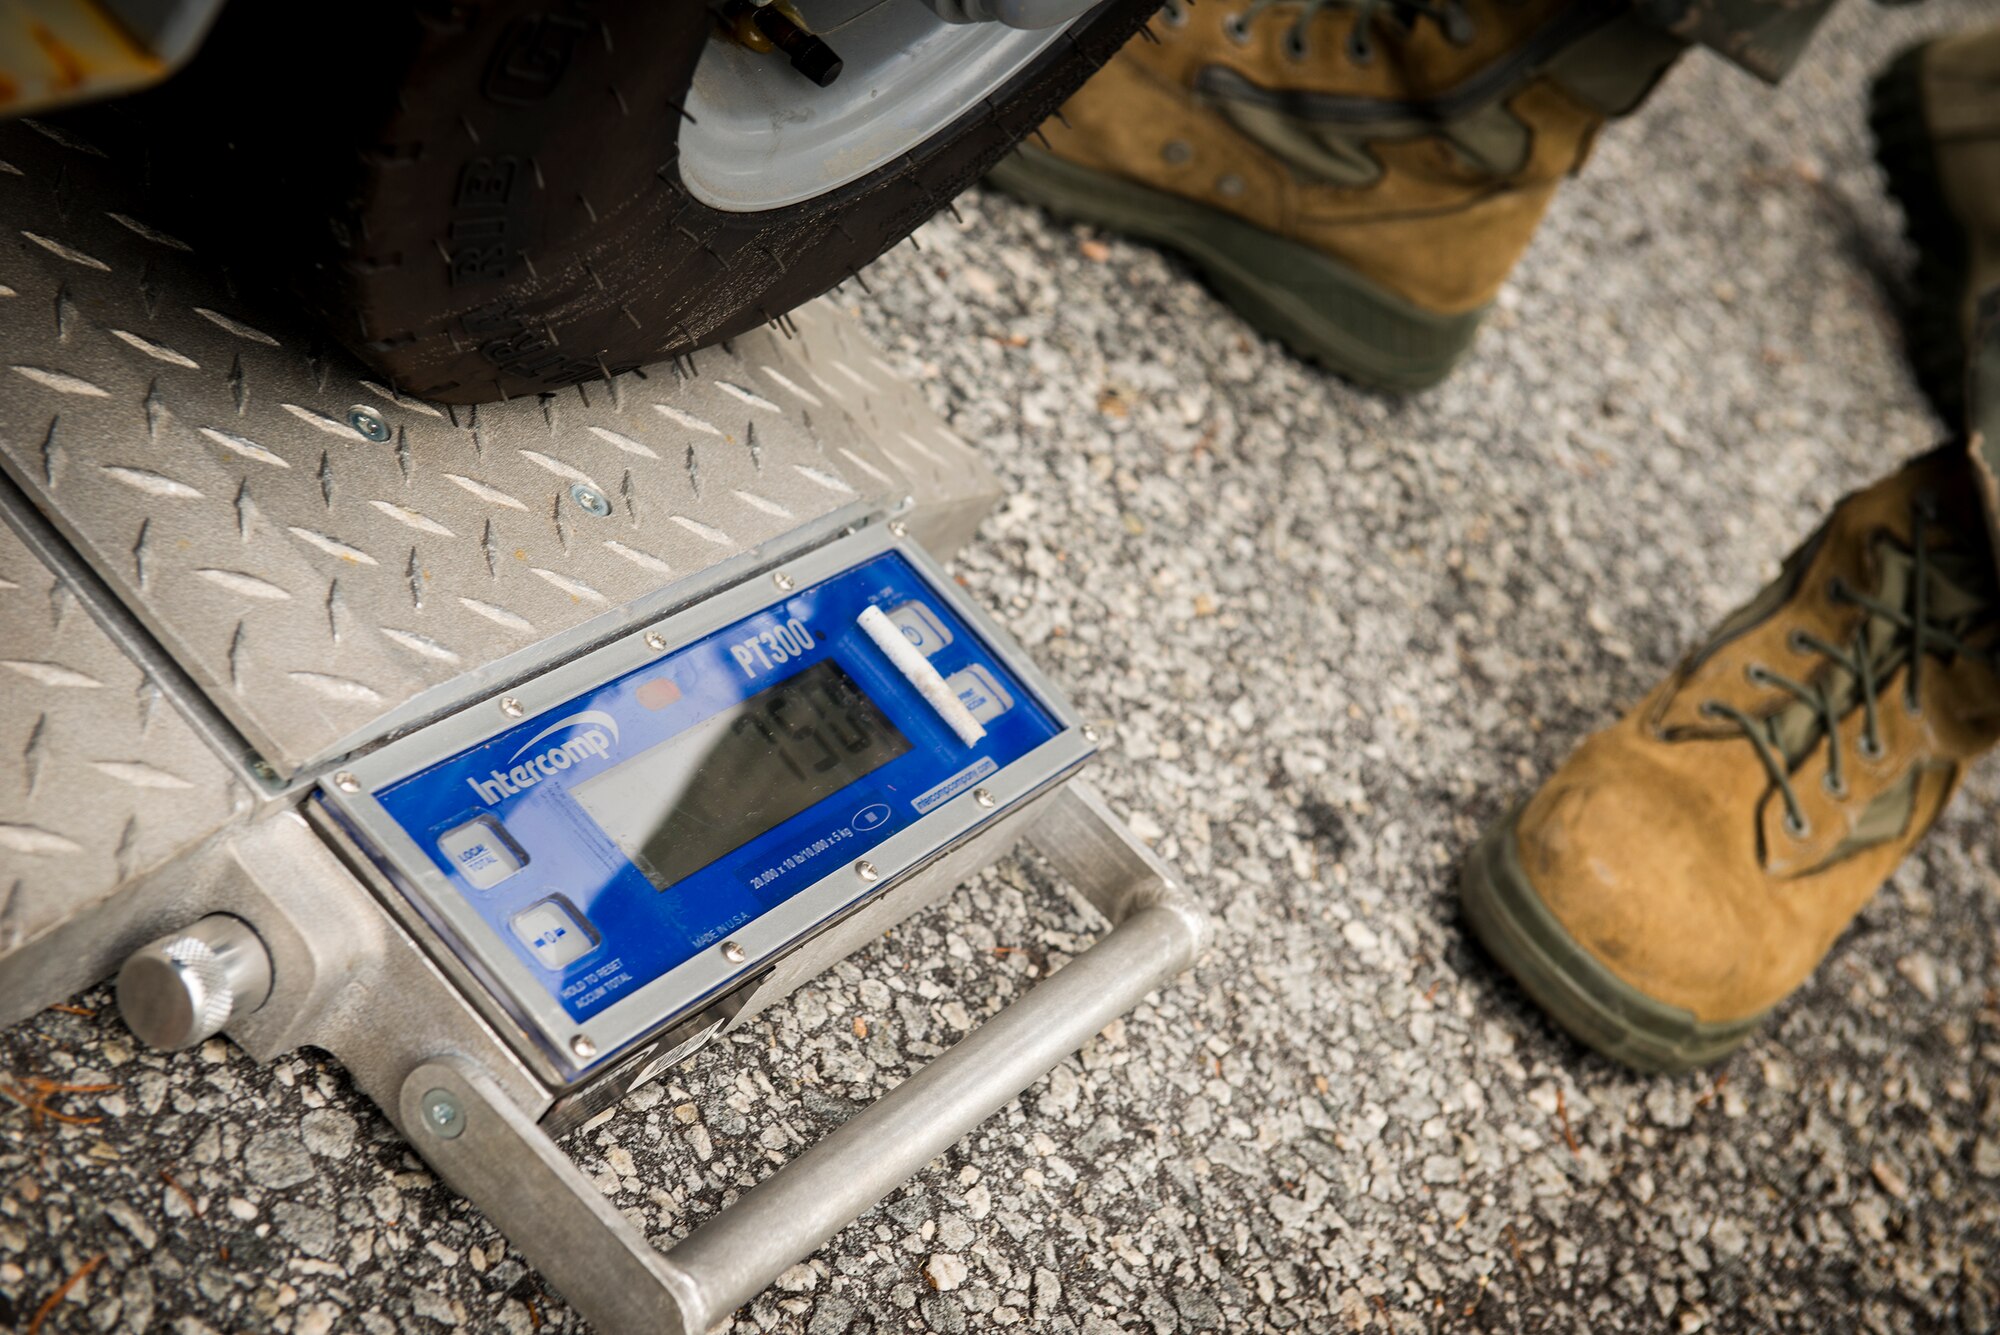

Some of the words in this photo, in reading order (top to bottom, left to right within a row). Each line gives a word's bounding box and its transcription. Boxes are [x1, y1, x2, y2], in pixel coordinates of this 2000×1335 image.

[450, 154, 518, 288] RIB
[730, 618, 815, 679] PT300
[466, 729, 610, 806] Intercomp
[457, 843, 489, 862] LOCAL
[468, 856, 498, 872] TOTAL
[750, 868, 779, 889] 20,000
[783, 858, 796, 870] 10
[834, 832, 842, 842] 5
[839, 826, 854, 839] kg
[691, 929, 718, 949] MADE
[716, 924, 727, 935] IN
[560, 981, 587, 999] HOLD
[584, 971, 599, 984] TO
[596, 958, 624, 978] RESET
[574, 985, 607, 1009] ACCUM
[605, 972, 633, 992] TOTAL
